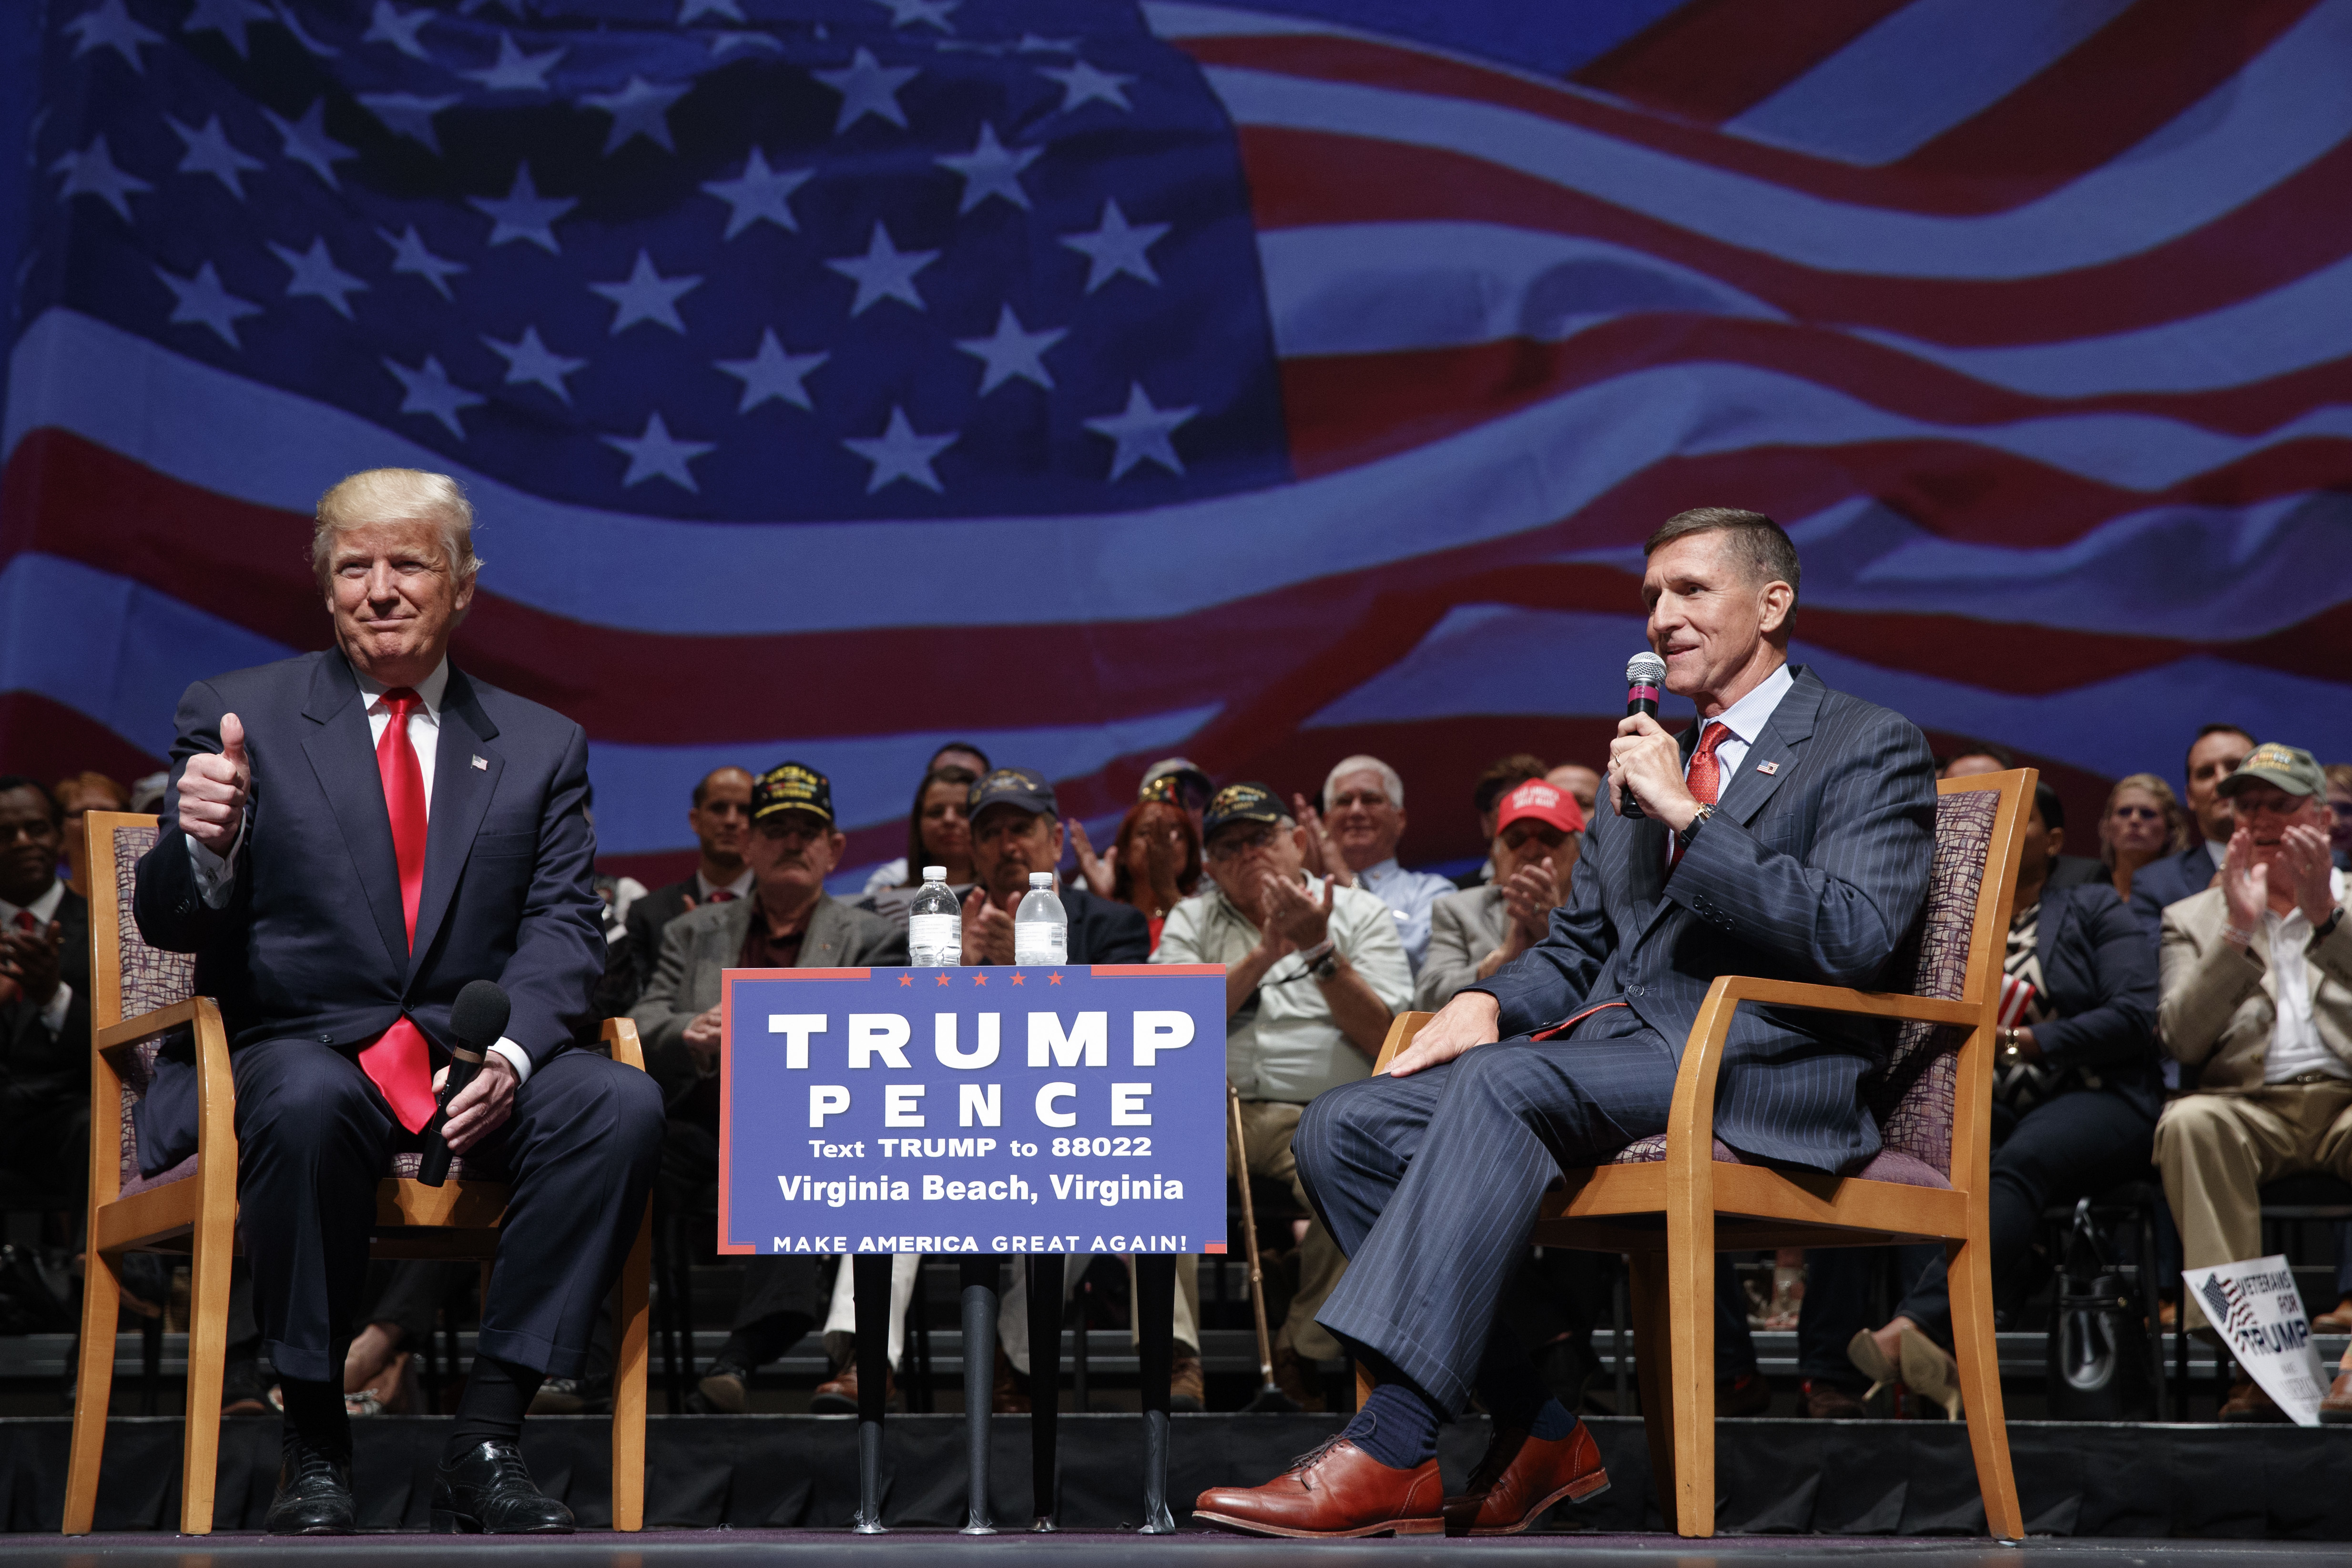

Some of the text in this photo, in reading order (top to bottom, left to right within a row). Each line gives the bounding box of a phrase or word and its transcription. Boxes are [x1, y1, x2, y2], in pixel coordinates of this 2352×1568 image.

[768, 1010, 1195, 1069] TRUMP
[809, 1081, 1152, 1128] PENCE
[808, 1137, 1152, 1158] Text TRUMP to 88022
[777, 1173, 1184, 1208] Virginia Beach, Virginia
[774, 1235, 1186, 1252] MAKE AMERICA GREAT AGAIN!
[2236, 1269, 2291, 1296] VETERANS
[2277, 1293, 2299, 1316] FOR
[2239, 1319, 2308, 1357] TRUMP
